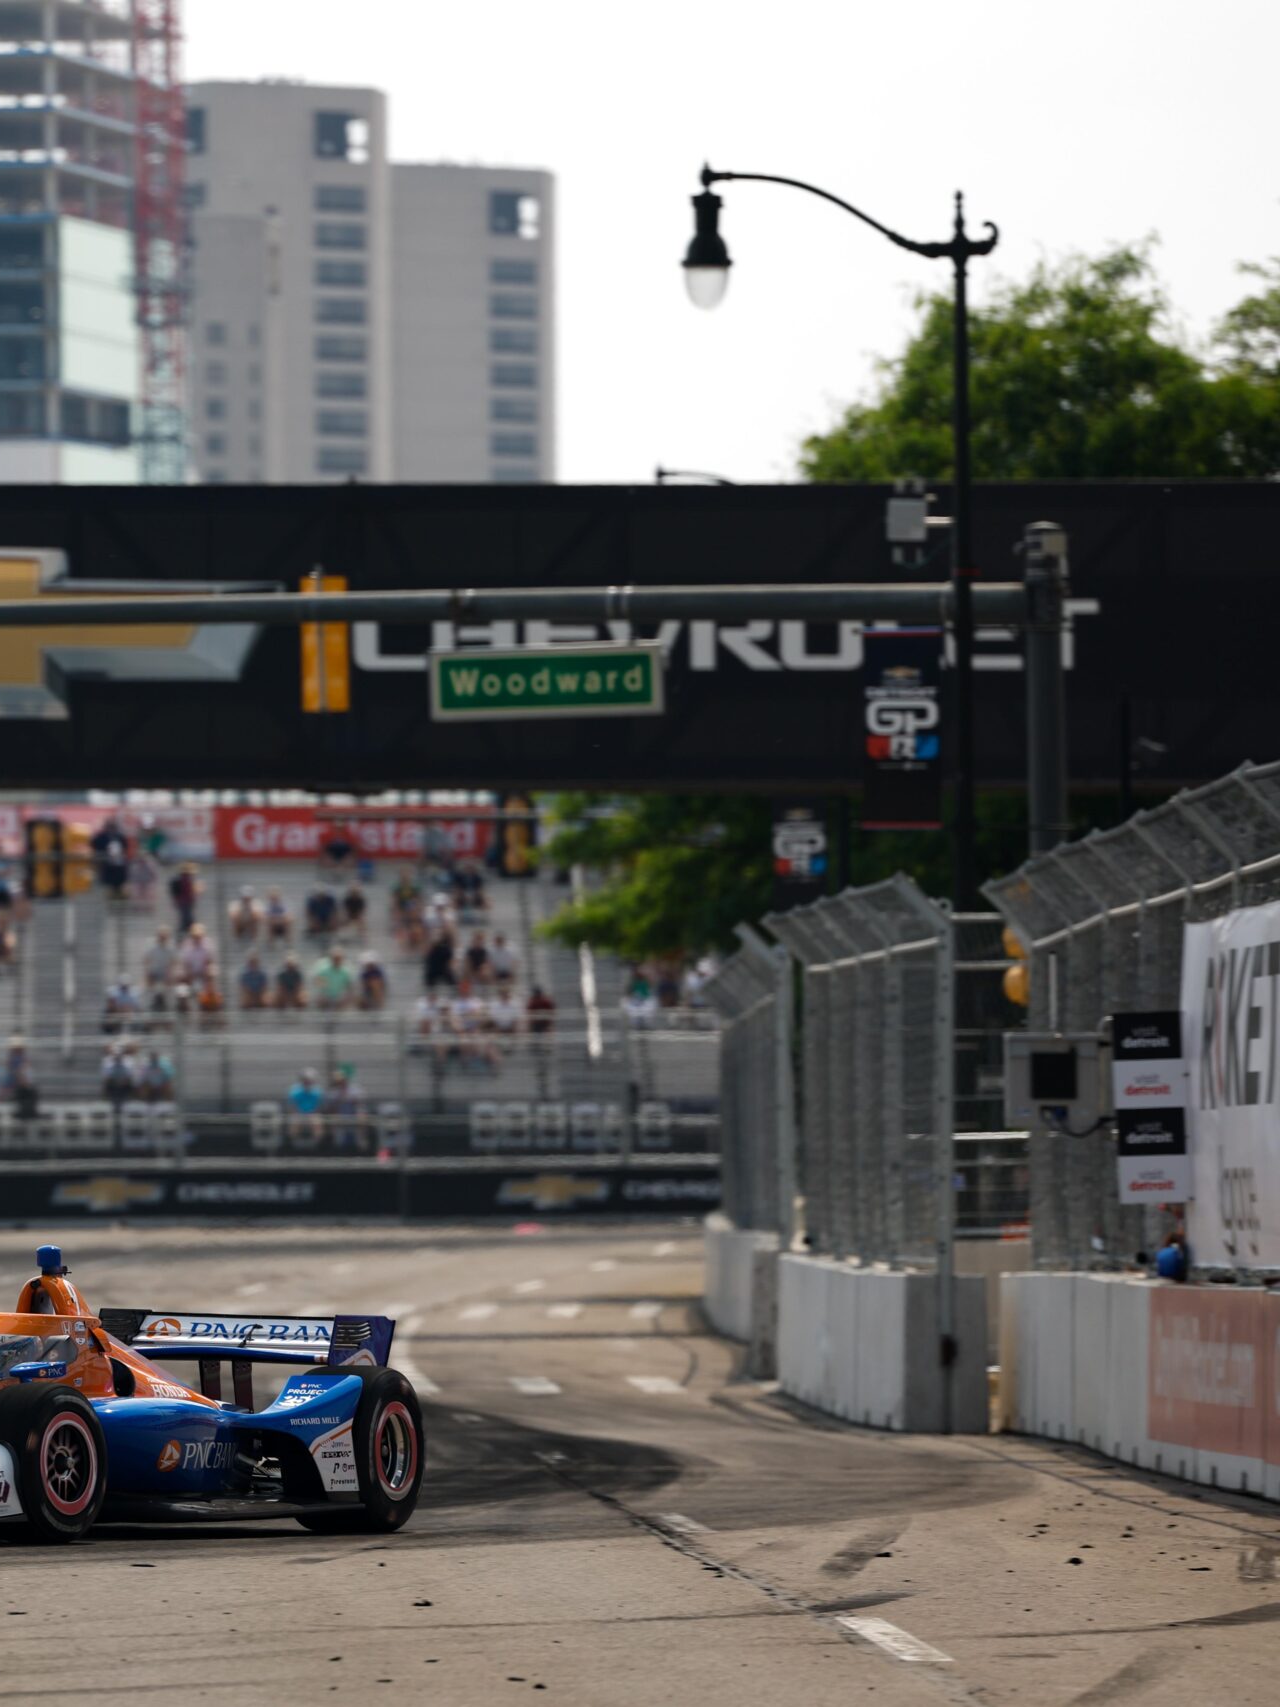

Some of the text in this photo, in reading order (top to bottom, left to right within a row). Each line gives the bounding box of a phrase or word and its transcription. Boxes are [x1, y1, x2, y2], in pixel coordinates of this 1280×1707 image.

[448, 664, 643, 696] Woodward
[865, 699, 939, 735] GP
[1122, 1037, 1169, 1048] detroit
[1124, 1085, 1171, 1096] detroit
[1126, 1132, 1174, 1144] detroit
[1128, 1180, 1176, 1192] detroit
[48, 1367, 64, 1377] PNC
[151, 1383, 193, 1398] HONDA
[290, 1416, 340, 1426] RICHARD MILLE
[330, 1478, 356, 1486] Firestone
